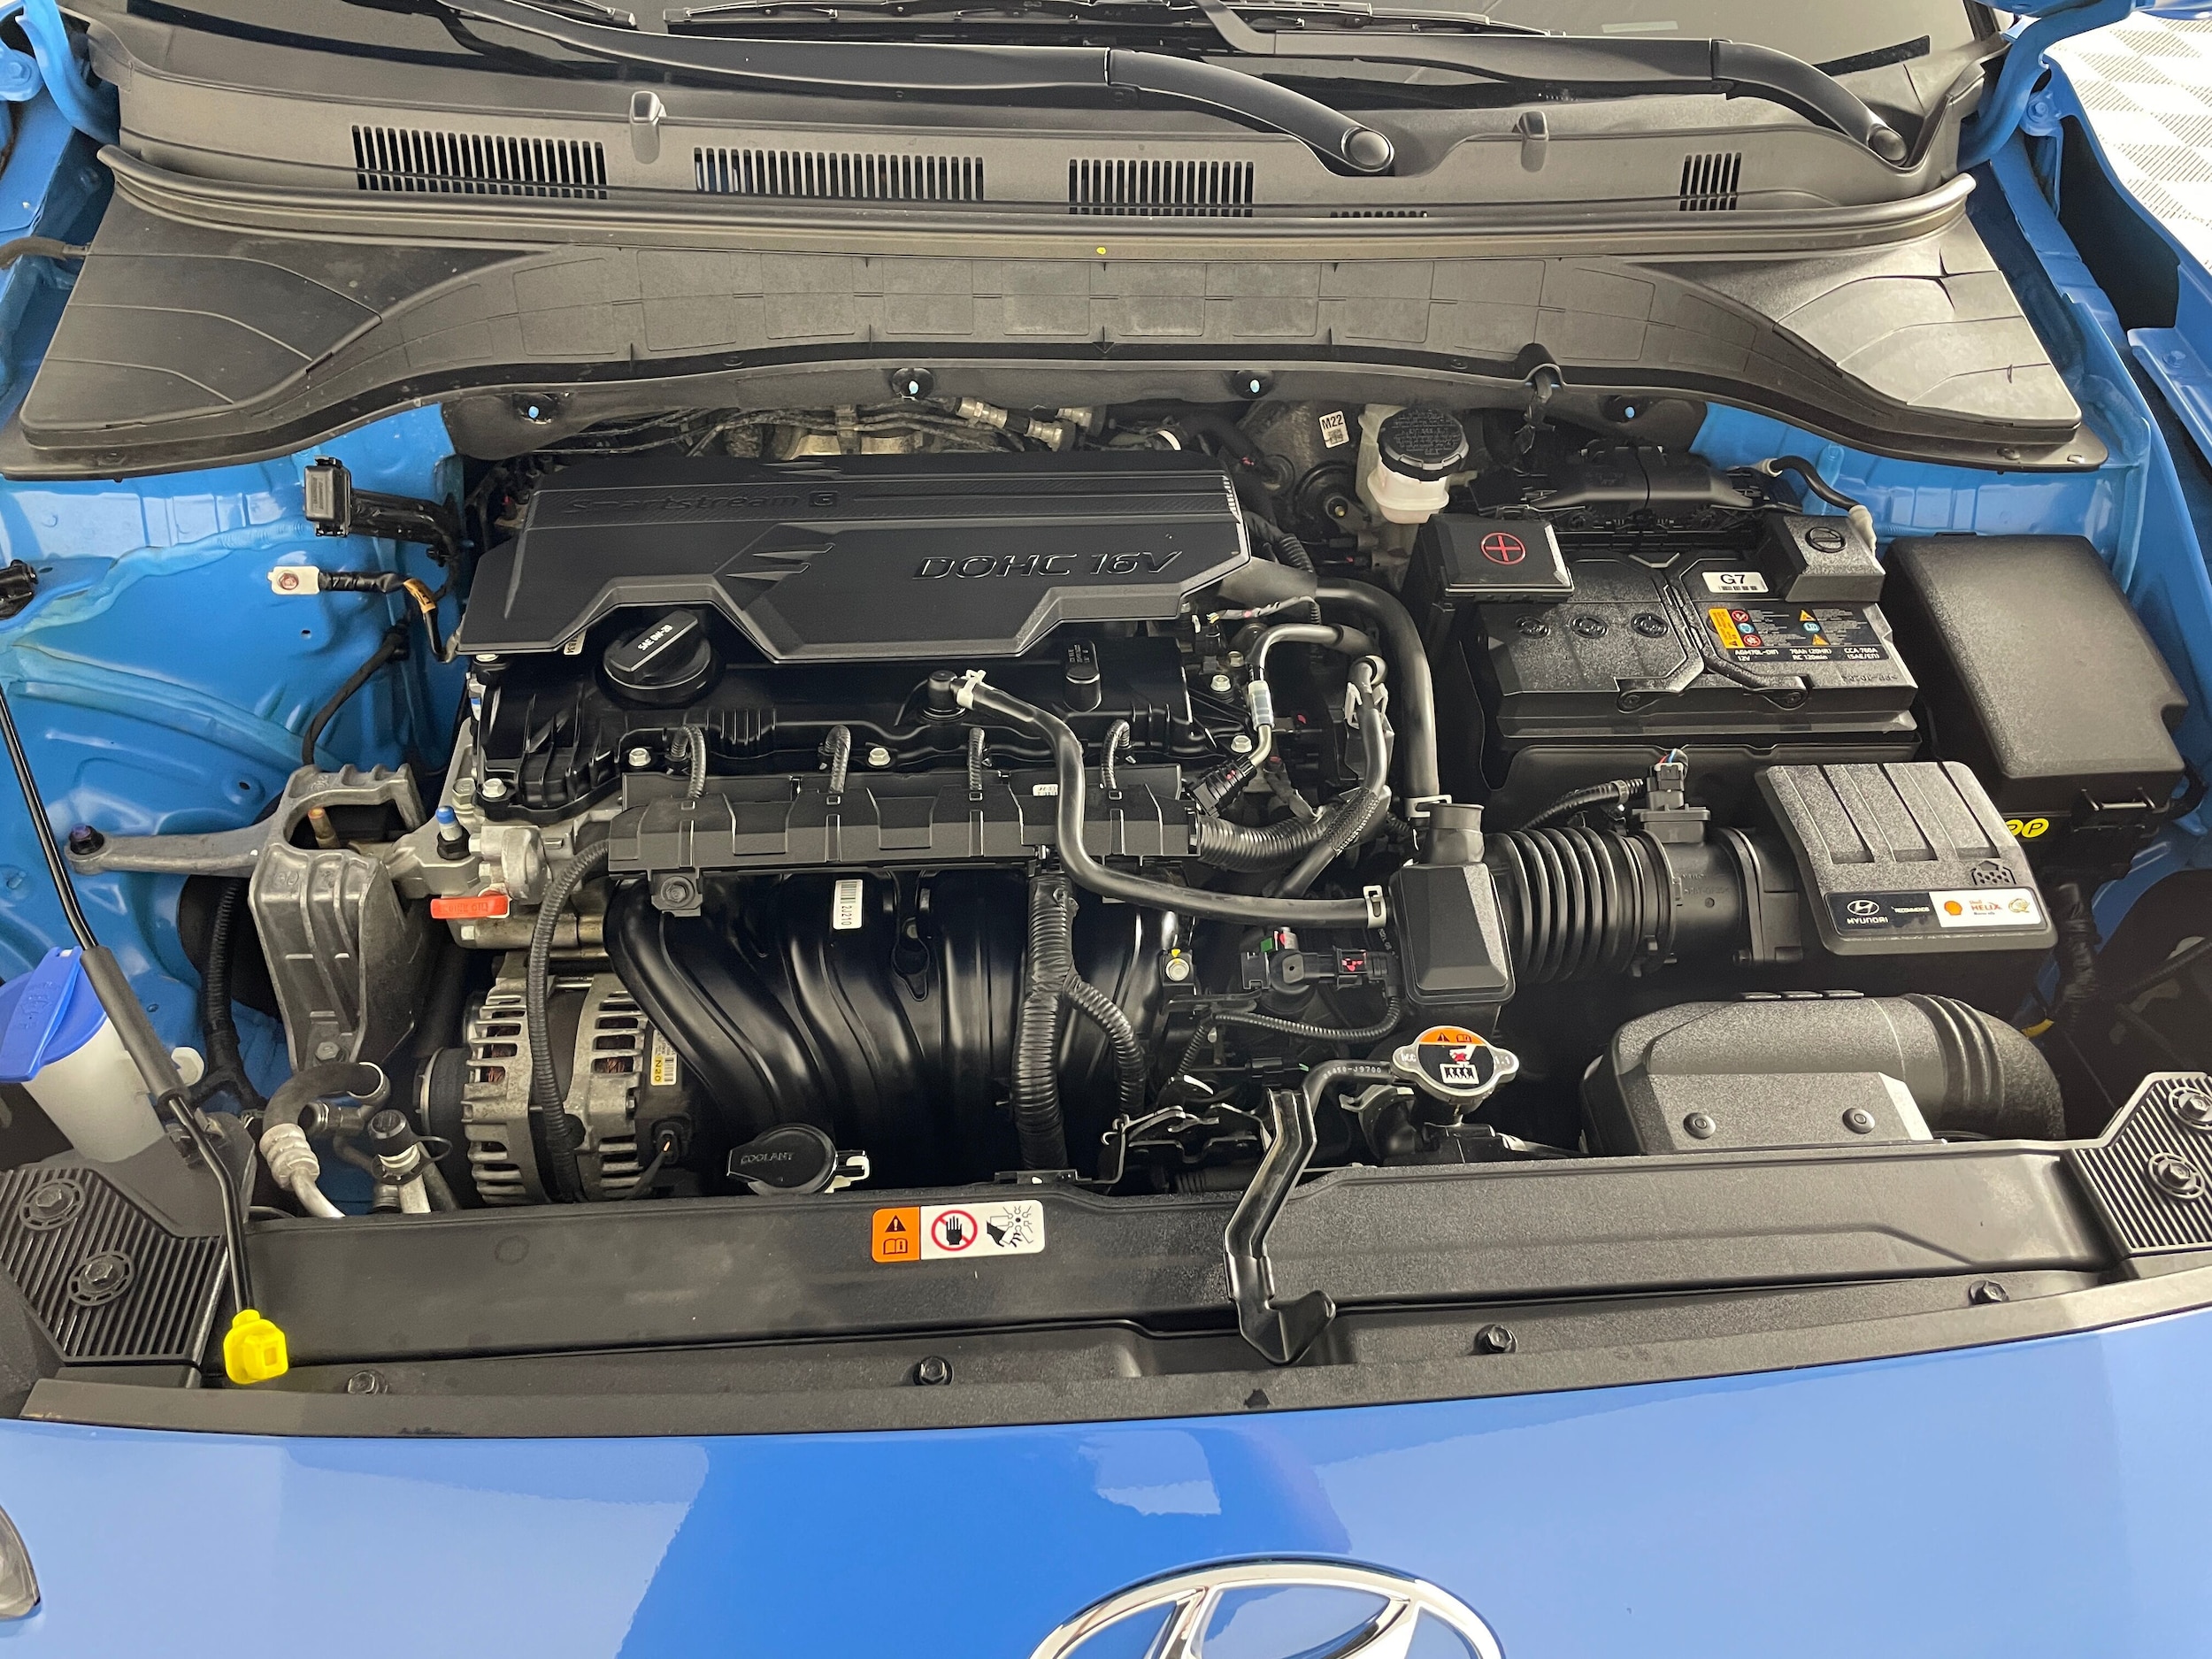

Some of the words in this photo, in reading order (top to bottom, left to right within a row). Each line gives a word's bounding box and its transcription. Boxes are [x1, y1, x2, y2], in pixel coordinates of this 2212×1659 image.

[1321, 414, 1344, 430] M22
[912, 554, 1078, 580] DOHC
[1090, 550, 1183, 575] 16V
[1719, 573, 1746, 585] G7
[637, 638, 655, 650] SAE
[2028, 822, 2044, 835] P
[841, 905, 853, 926] 2J210
[740, 1152, 795, 1165] COOLANT
